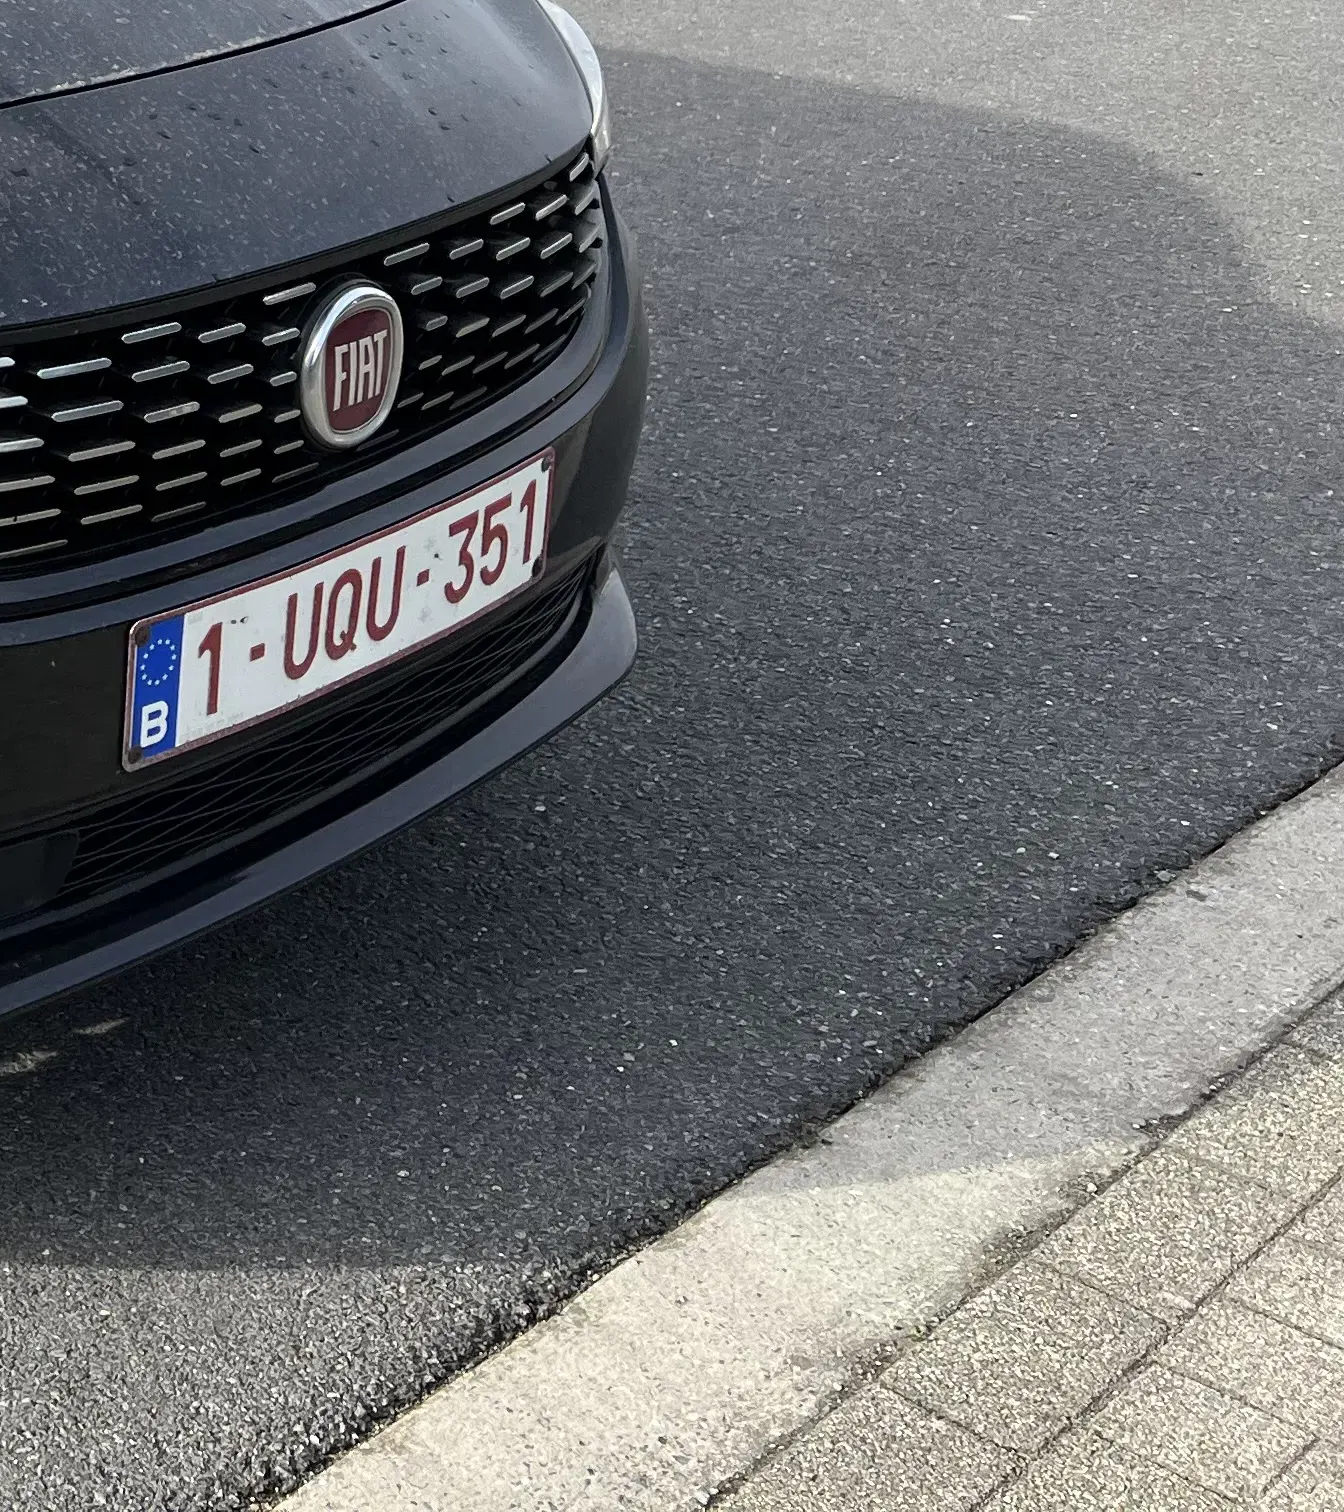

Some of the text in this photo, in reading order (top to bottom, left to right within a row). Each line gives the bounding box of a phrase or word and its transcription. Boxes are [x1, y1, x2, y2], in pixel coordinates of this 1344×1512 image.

[333, 328, 388, 411] FIAT
[140, 478, 538, 748] B 1-UQU-351
